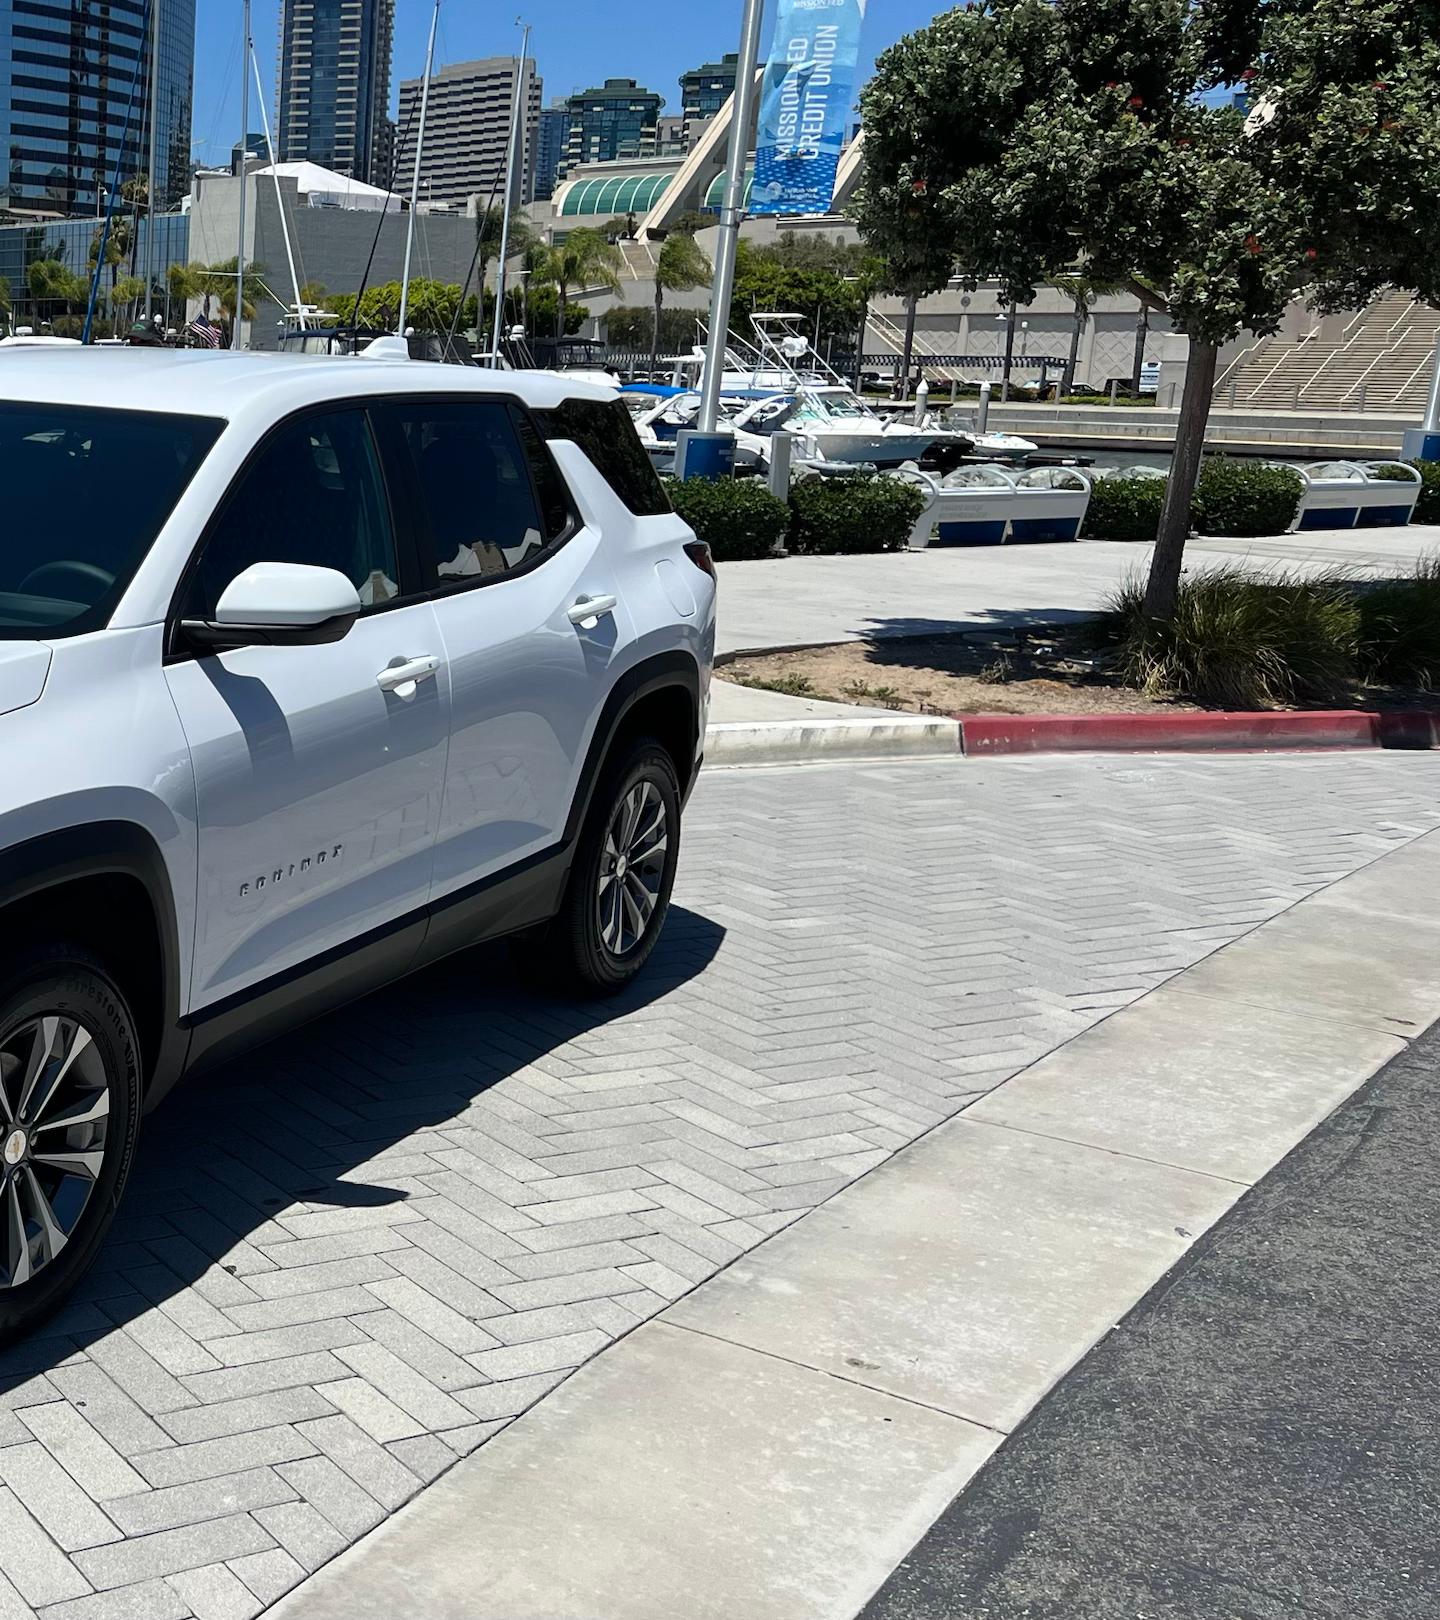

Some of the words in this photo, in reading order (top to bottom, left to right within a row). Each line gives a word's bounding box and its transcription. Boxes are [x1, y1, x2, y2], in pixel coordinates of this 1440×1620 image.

[786, 38, 809, 71] ED
[807, 25, 839, 87] UNION
[774, 79, 800, 161] MISSION
[800, 92, 828, 160] CREDIT
[240, 844, 342, 897] EQUINOX
